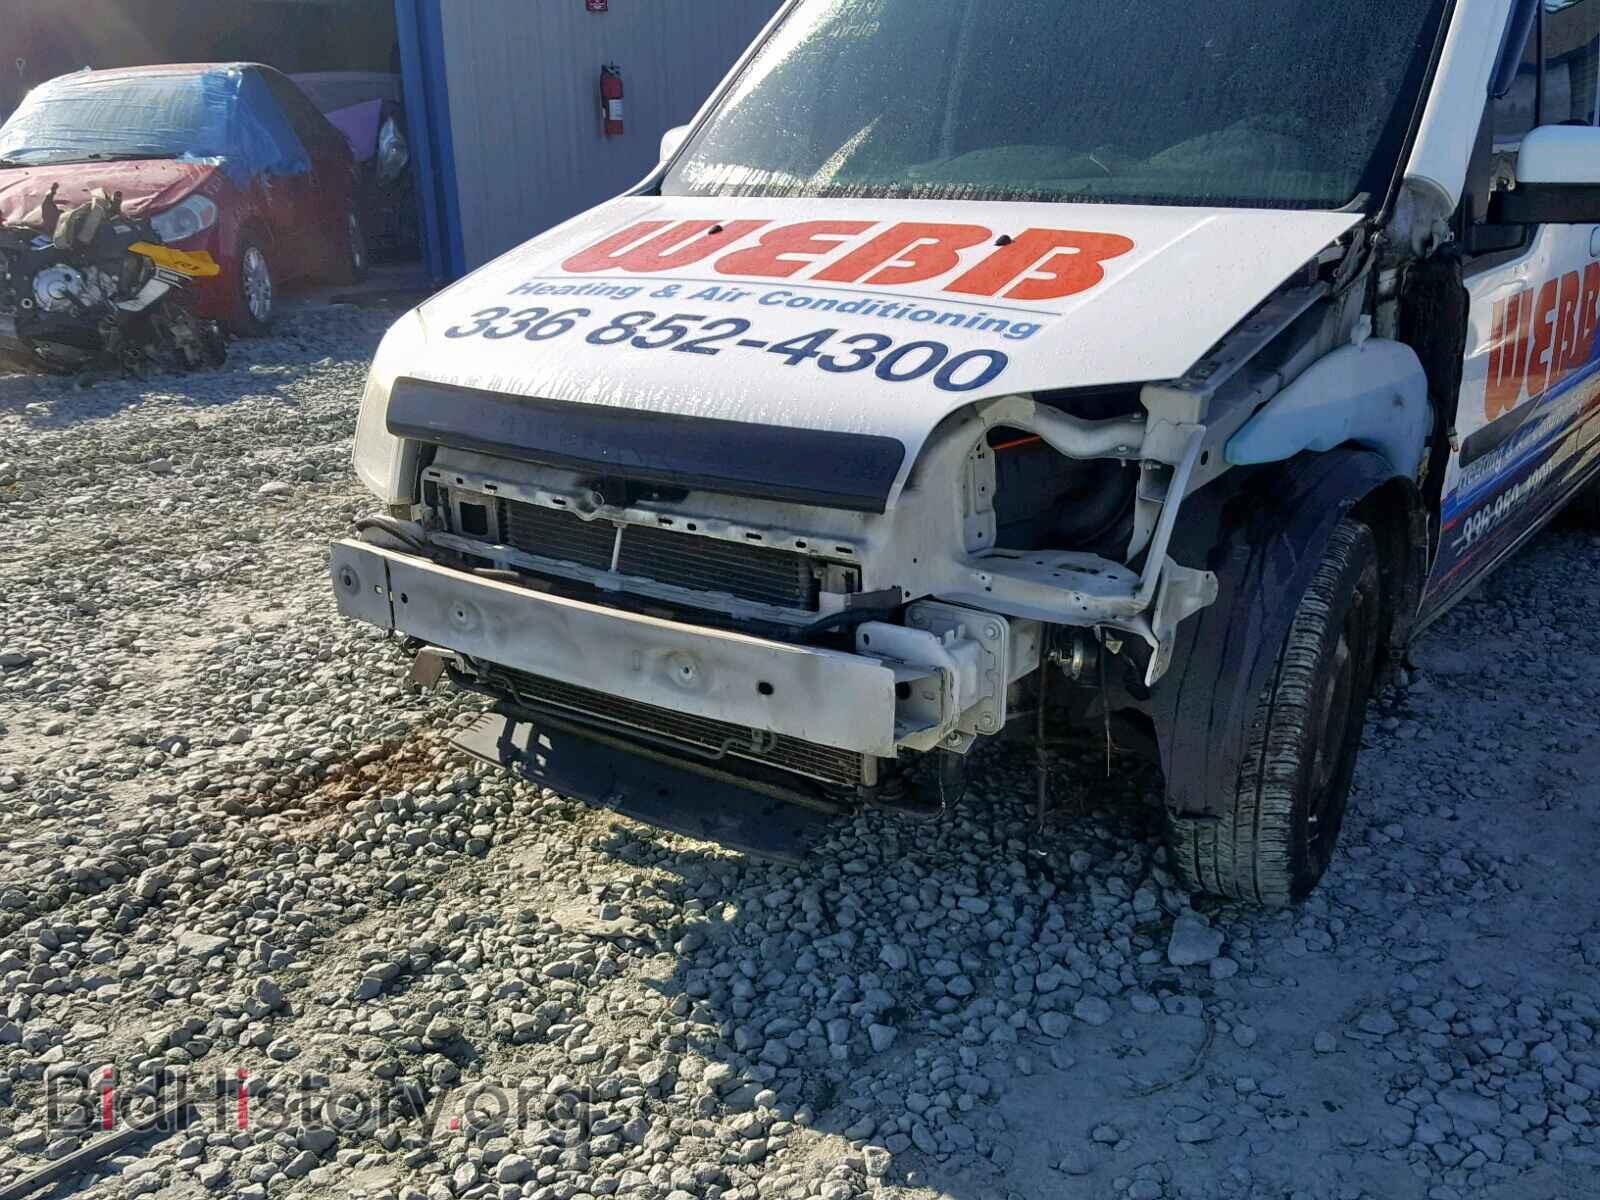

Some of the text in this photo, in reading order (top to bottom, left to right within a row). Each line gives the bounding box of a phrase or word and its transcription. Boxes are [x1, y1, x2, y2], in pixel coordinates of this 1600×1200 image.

[561, 219, 1135, 300] WEBB
[444, 306, 1010, 392] 336 852-4300
[507, 280, 1044, 340] Heating & Air Conditioning
[1484, 262, 1600, 421] WEBB
